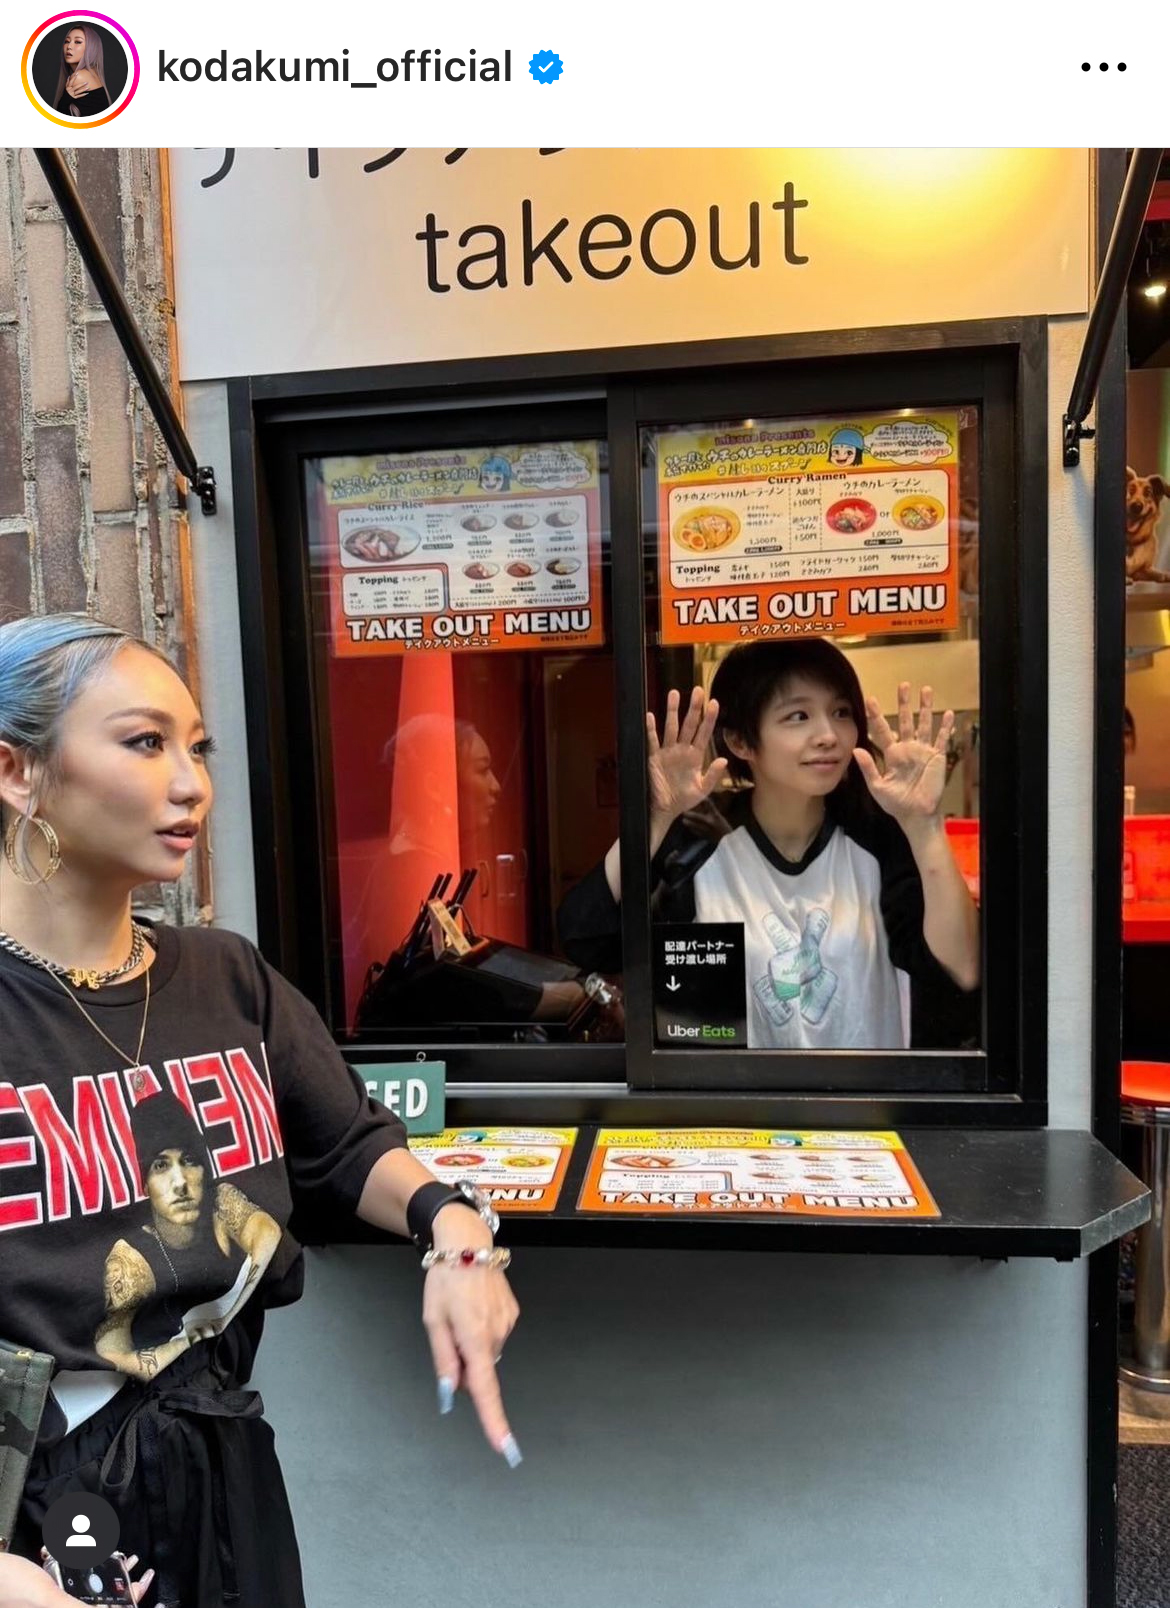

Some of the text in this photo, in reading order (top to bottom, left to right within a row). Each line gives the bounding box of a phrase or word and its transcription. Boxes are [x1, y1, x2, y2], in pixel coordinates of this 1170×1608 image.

[415, 181, 810, 294] takeout
[767, 471, 847, 486] Curry Ramen
[367, 500, 424, 513] Curry Rice
[676, 564, 721, 575] Topping
[359, 575, 399, 585] Topping
[673, 584, 947, 625] TAKE OUT MENU
[347, 609, 592, 641] TAKE OUT MENU
[739, 621, 846, 636] テイクアウトメニュー
[404, 636, 500, 650] テイクアウトメニュー
[664, 940, 735, 952] 配達パートナー
[665, 953, 727, 965] 受け渡し場所
[667, 1024, 735, 1037] Uber Eats
[599, 1191, 919, 1208] TAKE OUT MENU
